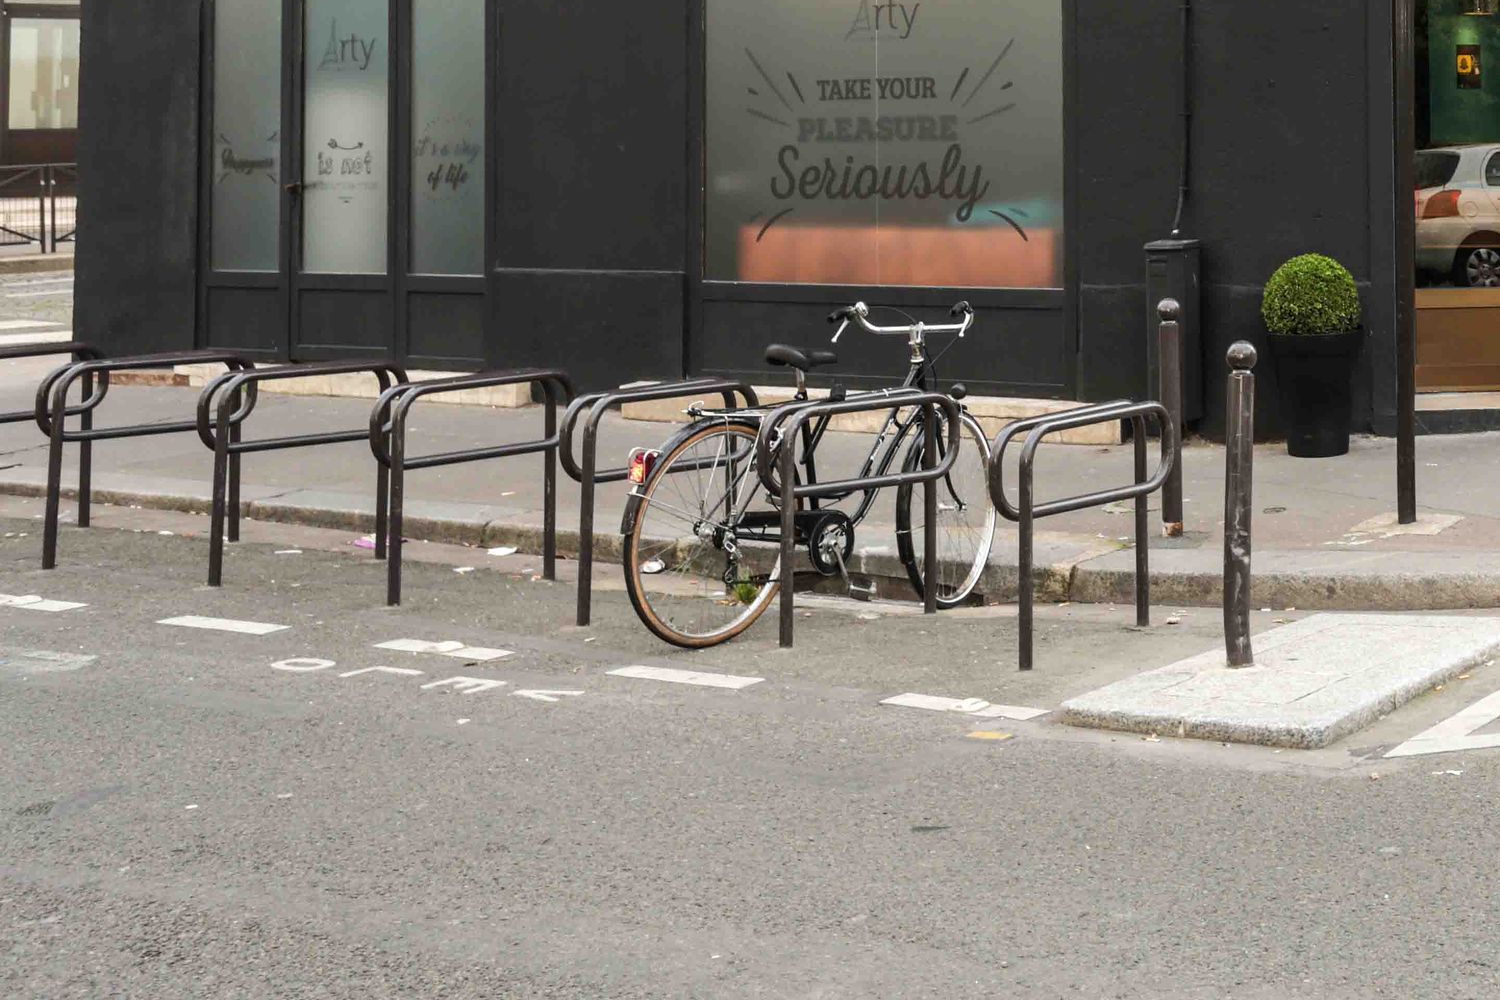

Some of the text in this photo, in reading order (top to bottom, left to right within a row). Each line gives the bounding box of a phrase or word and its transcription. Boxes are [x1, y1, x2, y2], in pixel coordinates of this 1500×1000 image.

[316, 16, 376, 71] Arty
[816, 76, 937, 101] TAKE YOUR
[797, 114, 959, 143] PLEASURE
[340, 150, 373, 175] not
[770, 143, 990, 222] Seriously
